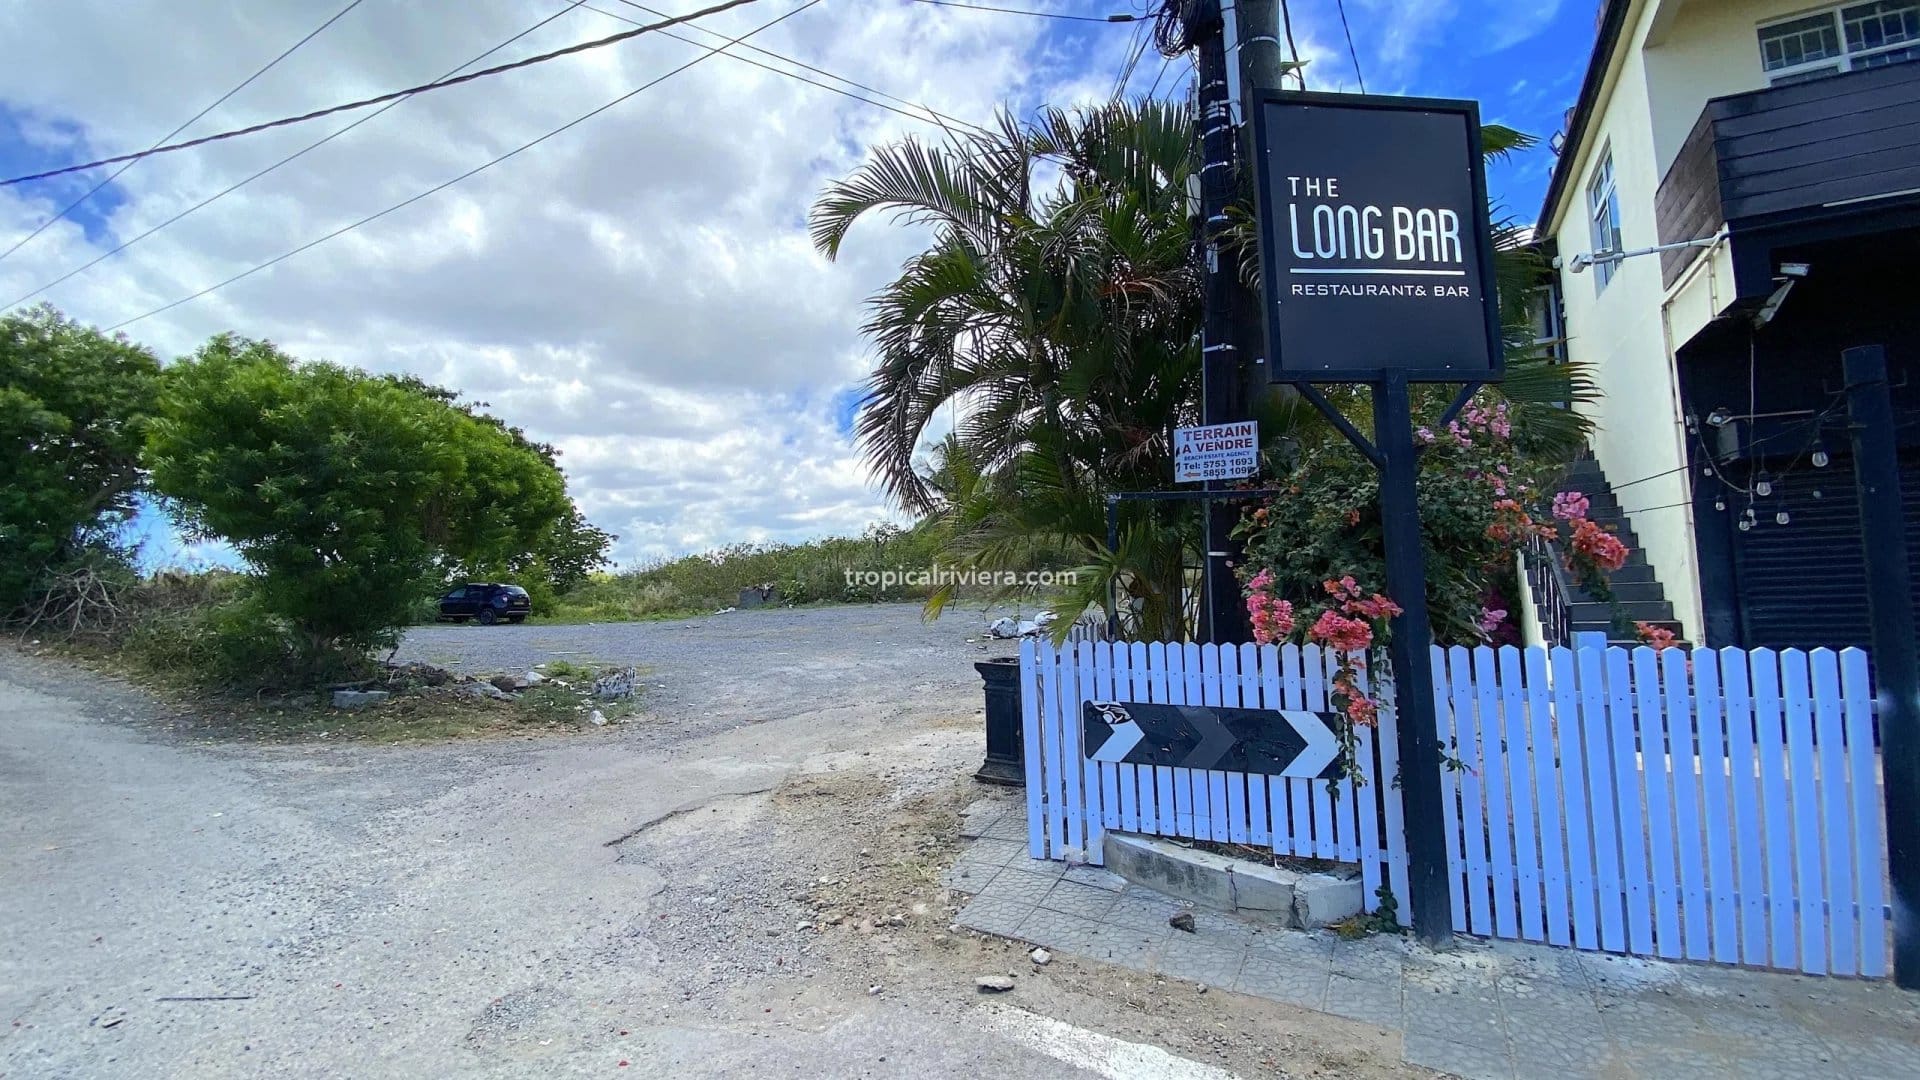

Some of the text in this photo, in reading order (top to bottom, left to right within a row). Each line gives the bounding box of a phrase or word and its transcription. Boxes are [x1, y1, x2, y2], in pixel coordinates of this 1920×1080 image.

[1288, 177, 1339, 197] THE
[1289, 204, 1462, 263] LONG BAR
[1292, 284, 1469, 298] RESTAURANT& BAR
[1183, 425, 1252, 442] TERRAIN
[1196, 438, 1253, 452] VENDRE
[1183, 458, 1253, 470] Tel: 5753 1693
[1203, 469, 1226, 477] 5859
